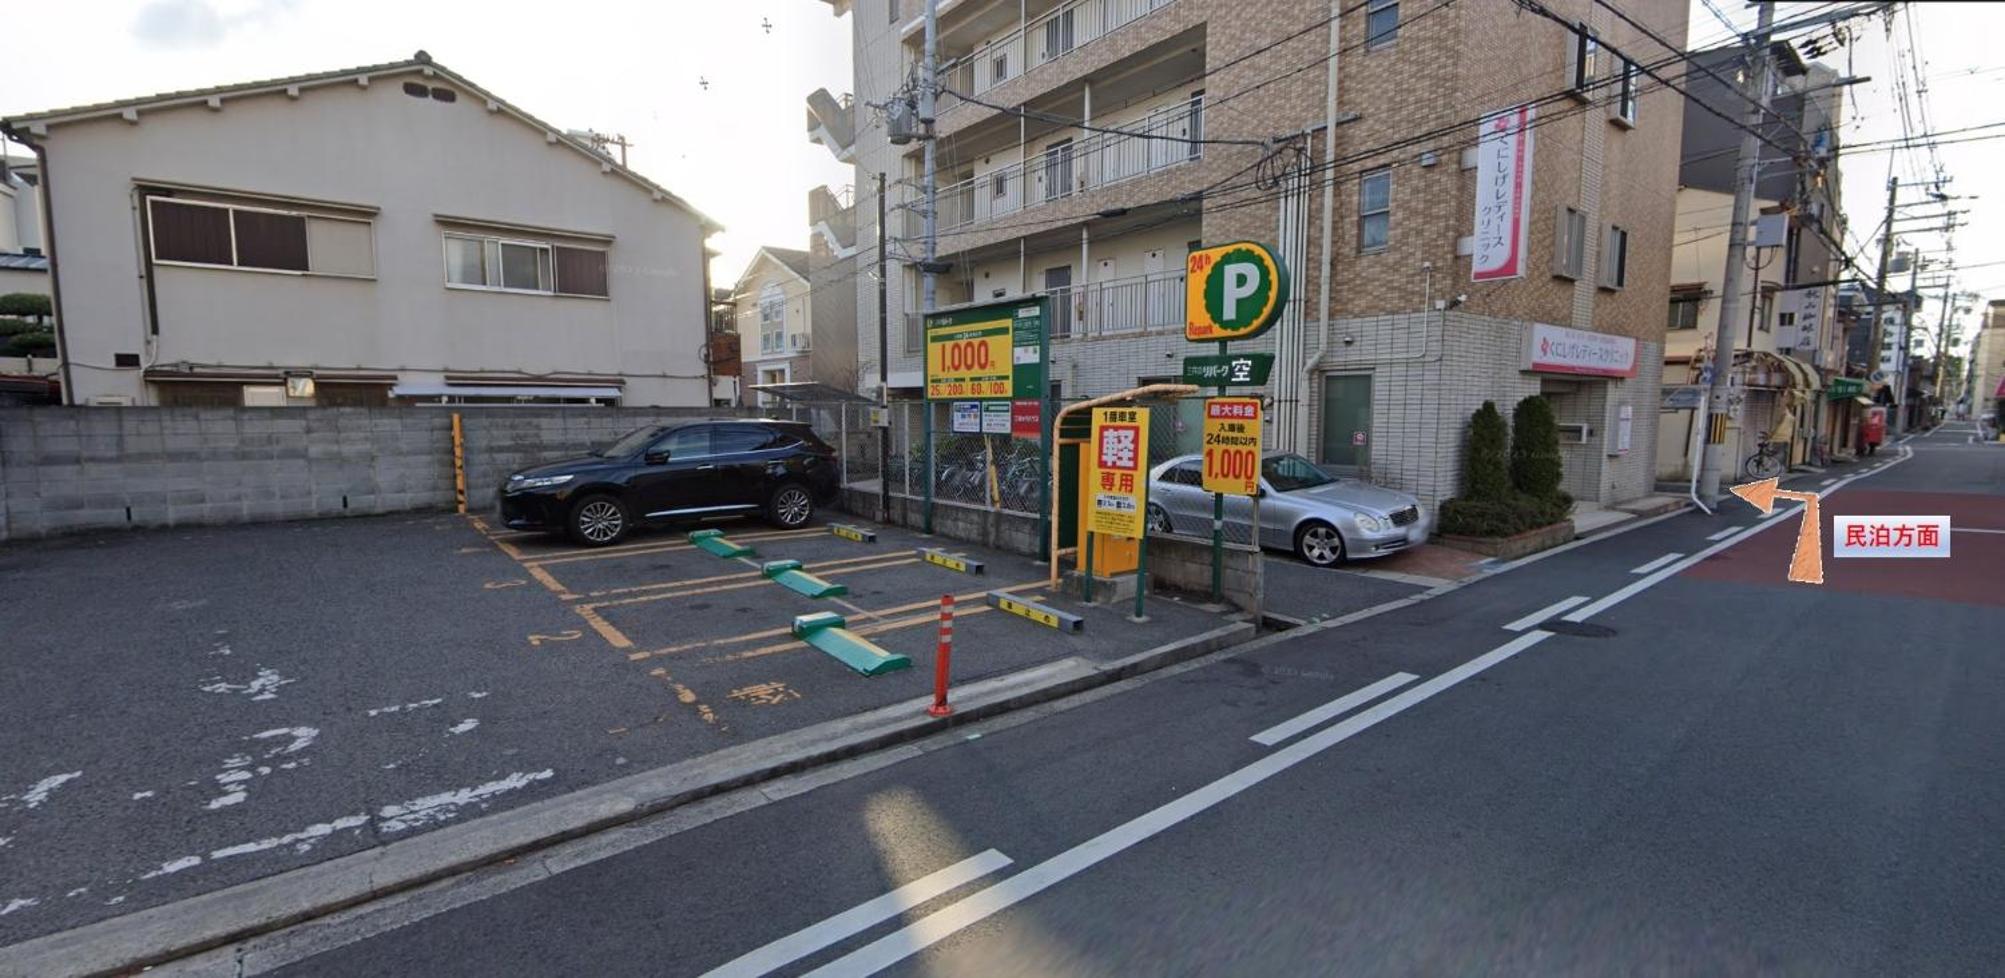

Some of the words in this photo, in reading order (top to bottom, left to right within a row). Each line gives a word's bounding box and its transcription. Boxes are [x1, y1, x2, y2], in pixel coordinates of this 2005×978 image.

[1479, 205, 1492, 265] クリニック
[1190, 253, 1211, 273] 24h
[1222, 262, 1261, 322] P
[1231, 358, 1252, 382] 空
[1103, 411, 1137, 423] 1番車室
[1210, 405, 1255, 417] 最大料金
[1219, 423, 1246, 433] 入庫後
[1102, 428, 1135, 467] 軽
[1206, 433, 1257, 446] 24時間以内
[1101, 471, 1134, 494] 専用
[1245, 481, 1255, 492] 円
